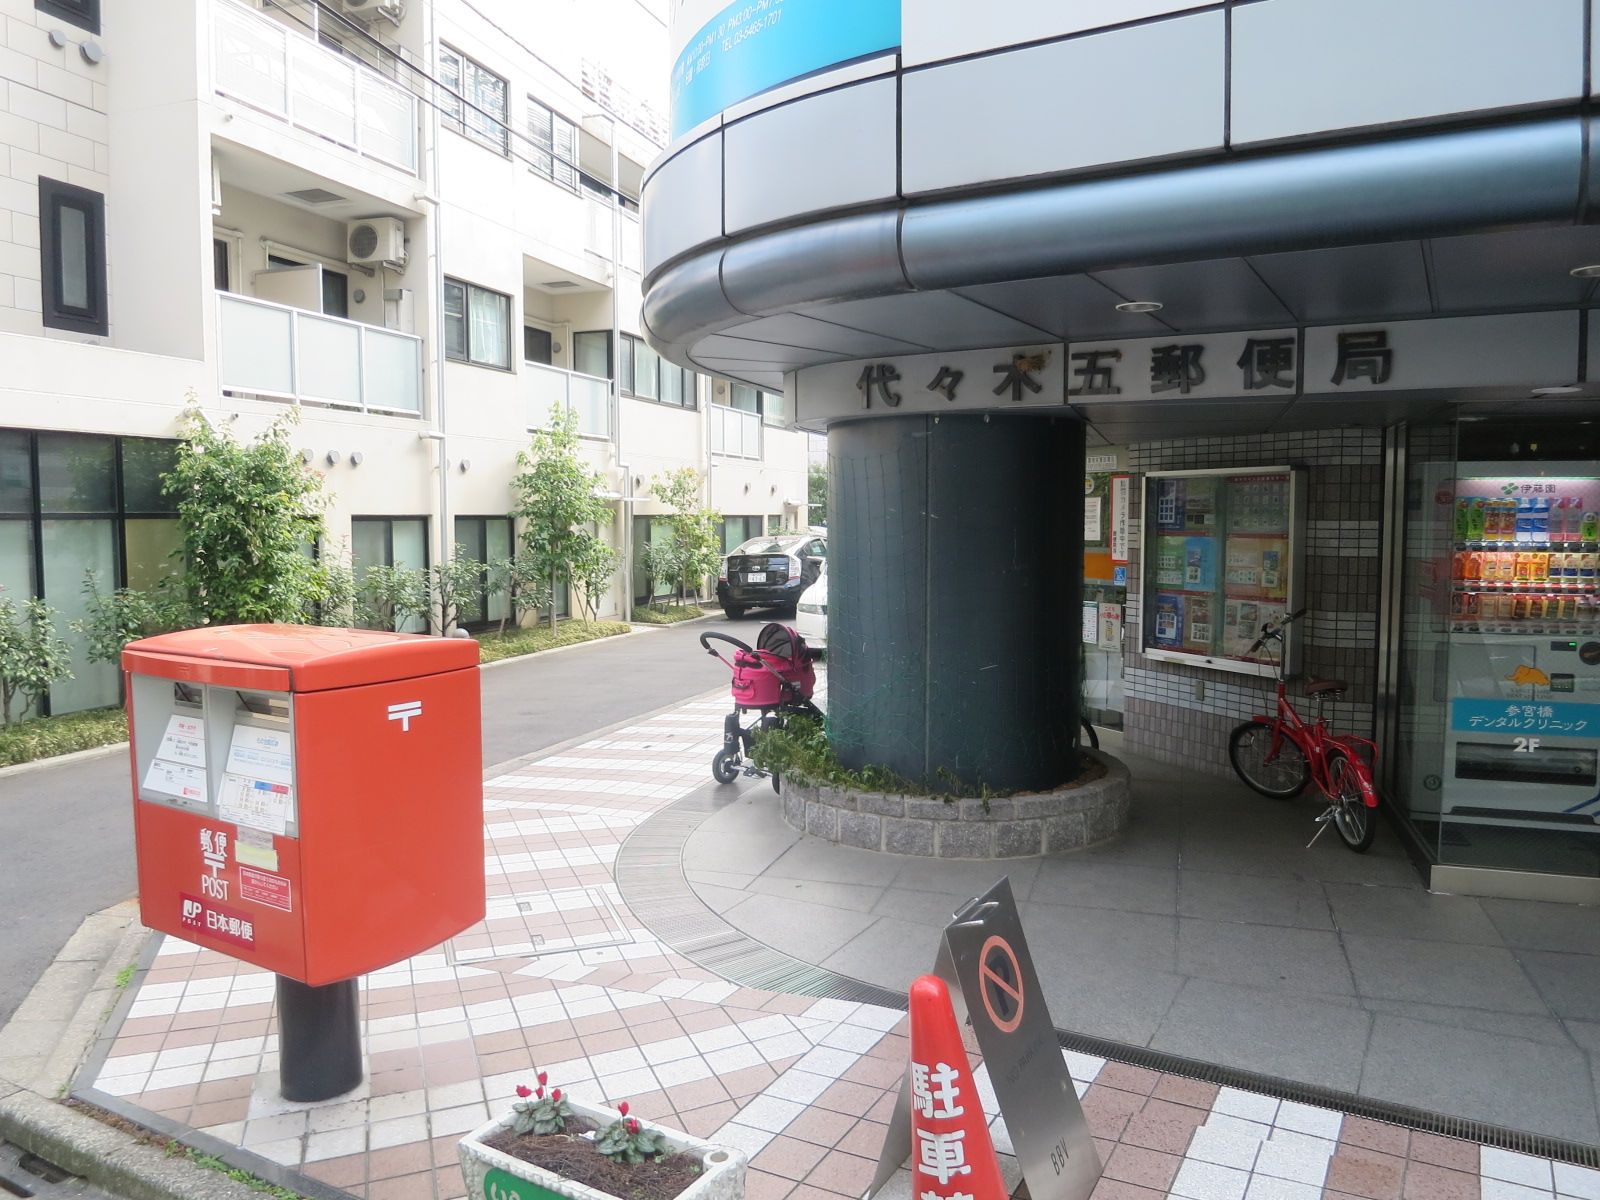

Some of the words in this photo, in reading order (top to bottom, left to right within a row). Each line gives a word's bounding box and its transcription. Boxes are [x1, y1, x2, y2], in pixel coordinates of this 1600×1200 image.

[856, 330, 1391, 410] 代々木五郵便局
[1468, 715, 1588, 731] デンタルクリニック
[1505, 705, 1553, 718] 参宮橋
[1512, 737, 1540, 753] 2F
[200, 828, 228, 857] 郵便
[201, 874, 229, 901] POST
[206, 909, 254, 941] 日本郵便
[911, 1061, 975, 1200] 駐車
[1050, 1136, 1069, 1175] BBV
